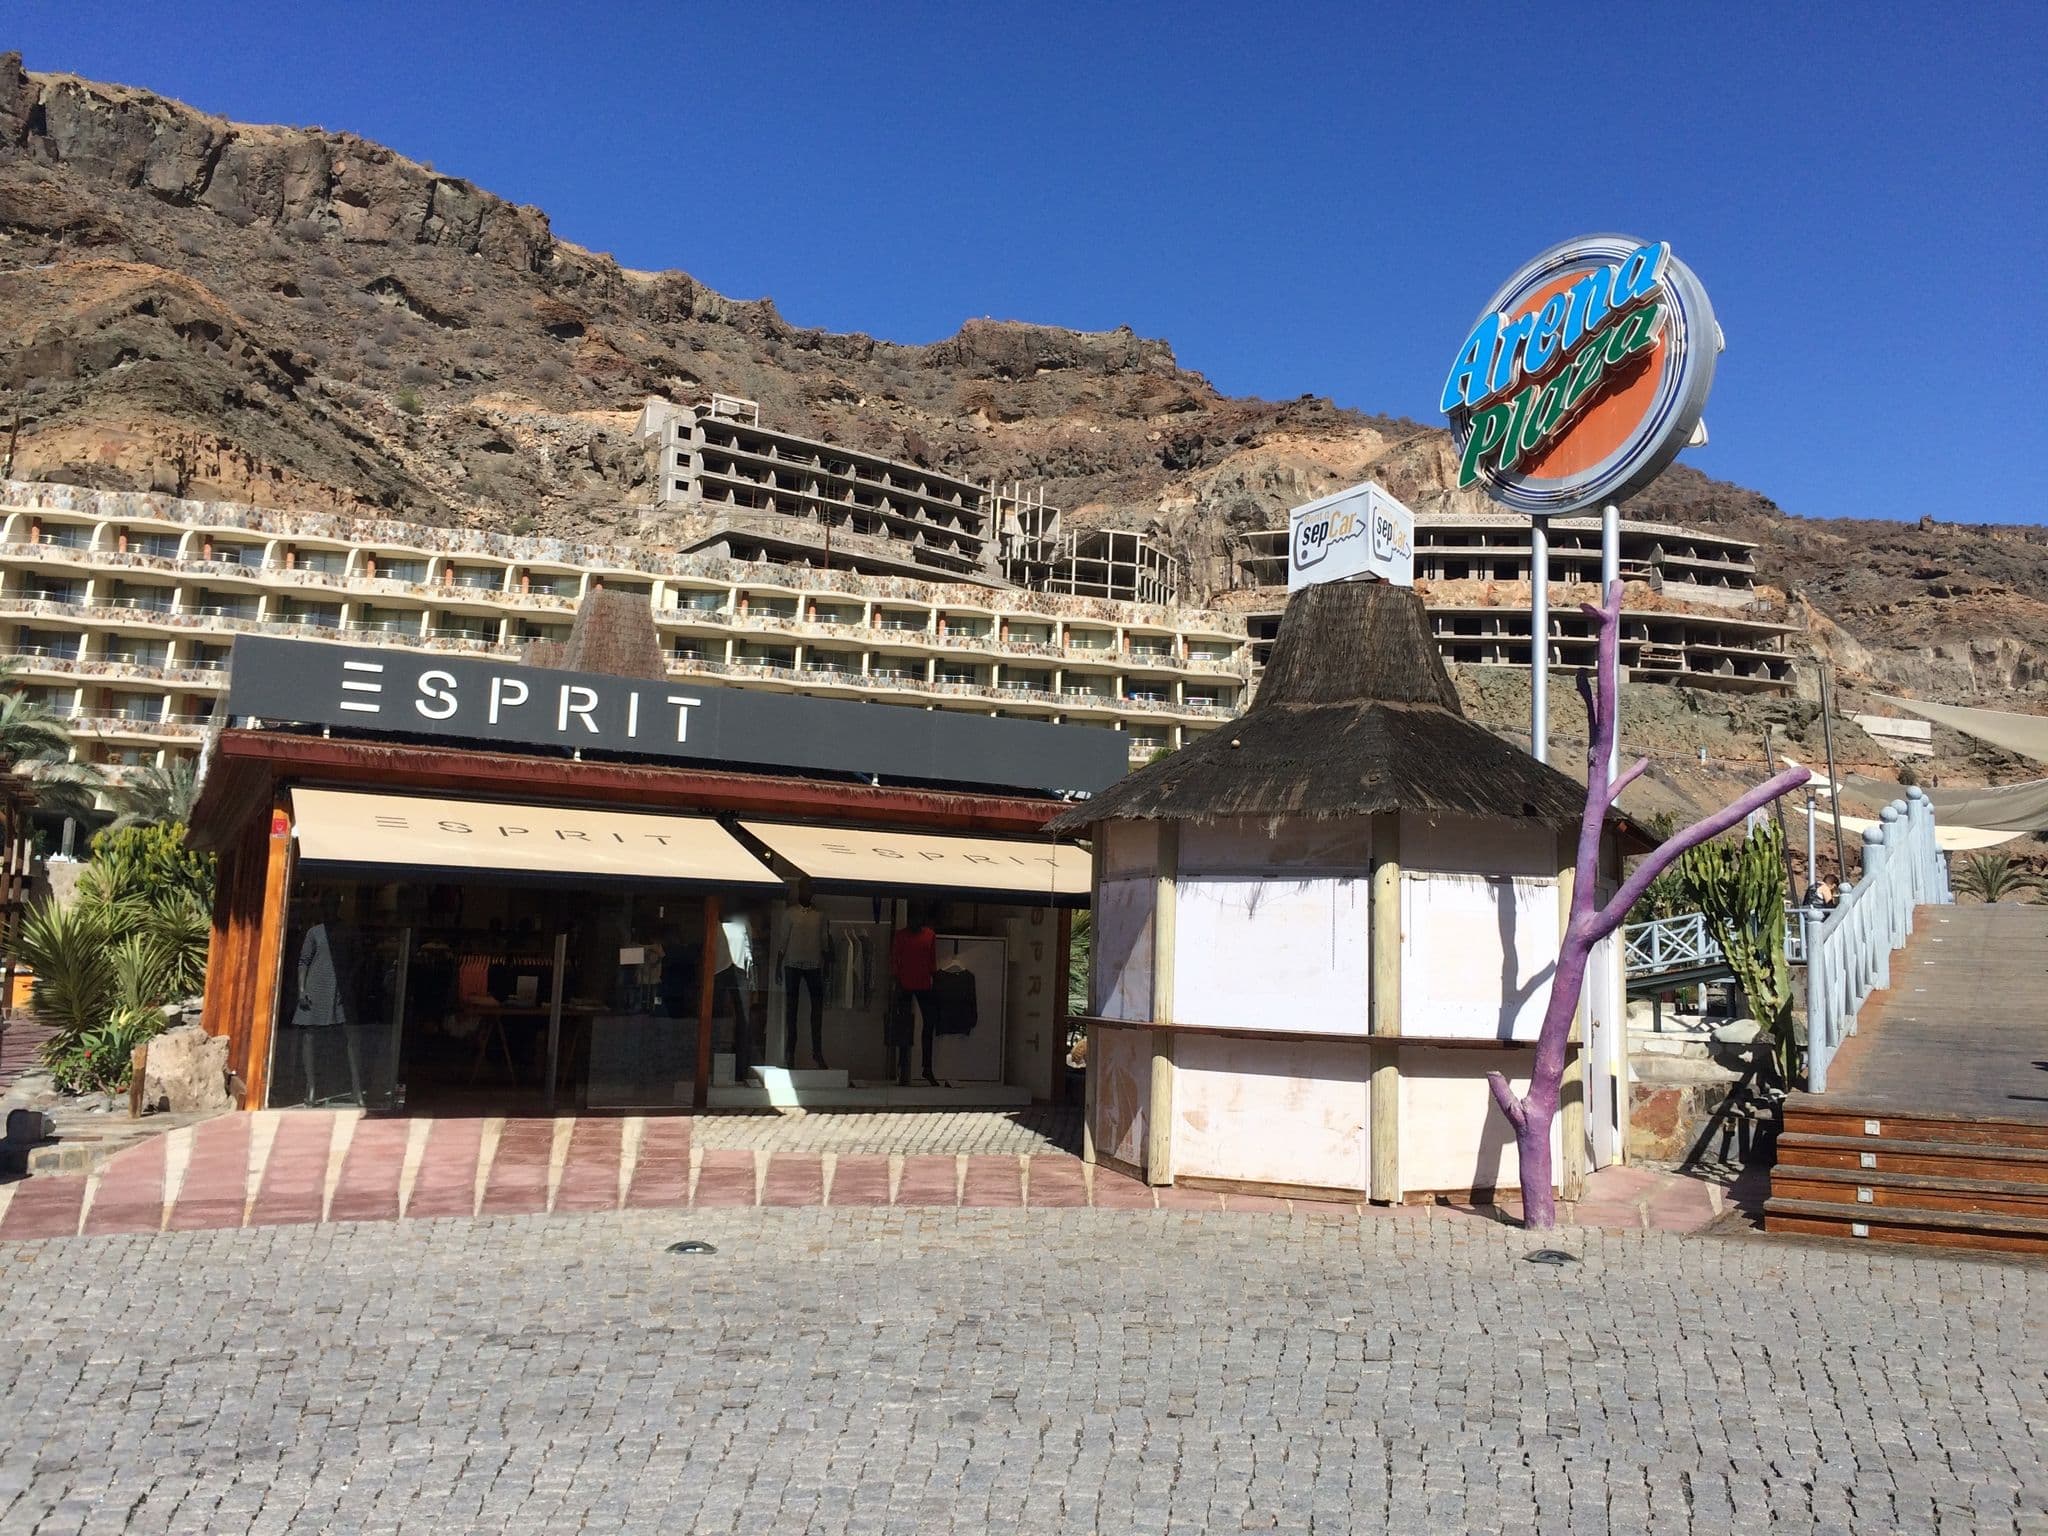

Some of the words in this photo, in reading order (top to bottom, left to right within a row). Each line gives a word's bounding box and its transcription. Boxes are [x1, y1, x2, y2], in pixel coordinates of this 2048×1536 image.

[1440, 241, 1669, 413] Arena
[1457, 303, 1667, 488] Plaza
[340, 660, 702, 743] ESPRIT
[375, 815, 672, 846] ESPRIT
[821, 843, 1060, 867] ESPRIT
